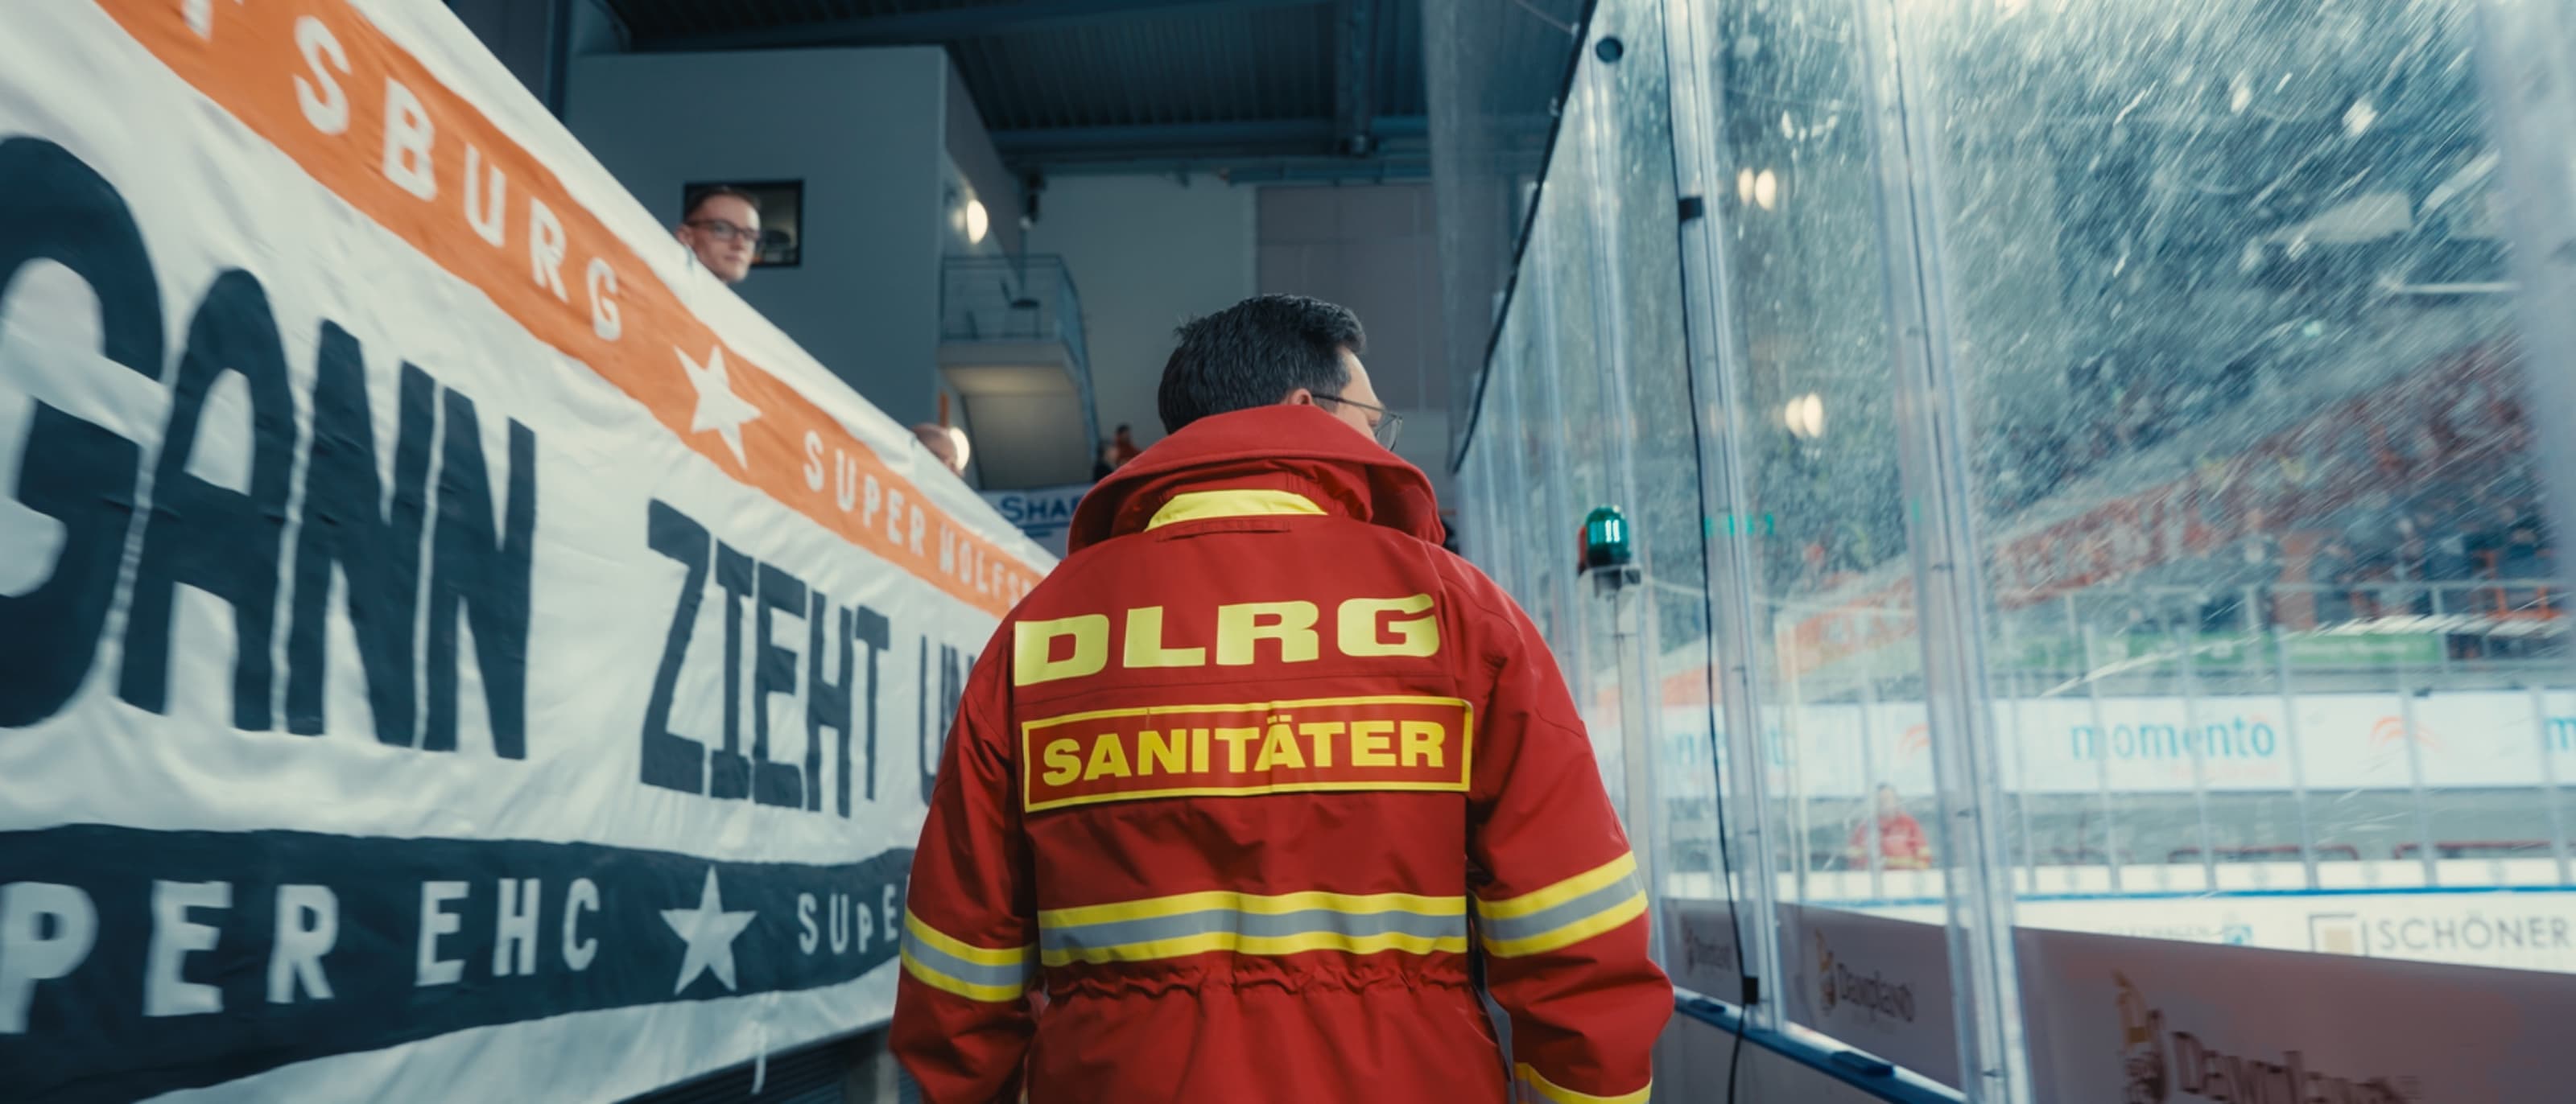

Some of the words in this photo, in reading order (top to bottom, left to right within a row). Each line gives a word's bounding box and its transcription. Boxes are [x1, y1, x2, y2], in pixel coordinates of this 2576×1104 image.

[803, 430, 925, 557] SUPER
[1001, 495, 1080, 521] SHA
[641, 497, 890, 819] ZIEHT
[1014, 594, 1440, 686] DLRG
[1042, 715, 1445, 786] SANITÄTER
[415, 877, 601, 987] EHC
[797, 872, 910, 955] SUPE
[2376, 910, 2572, 950] SCHÖNER
